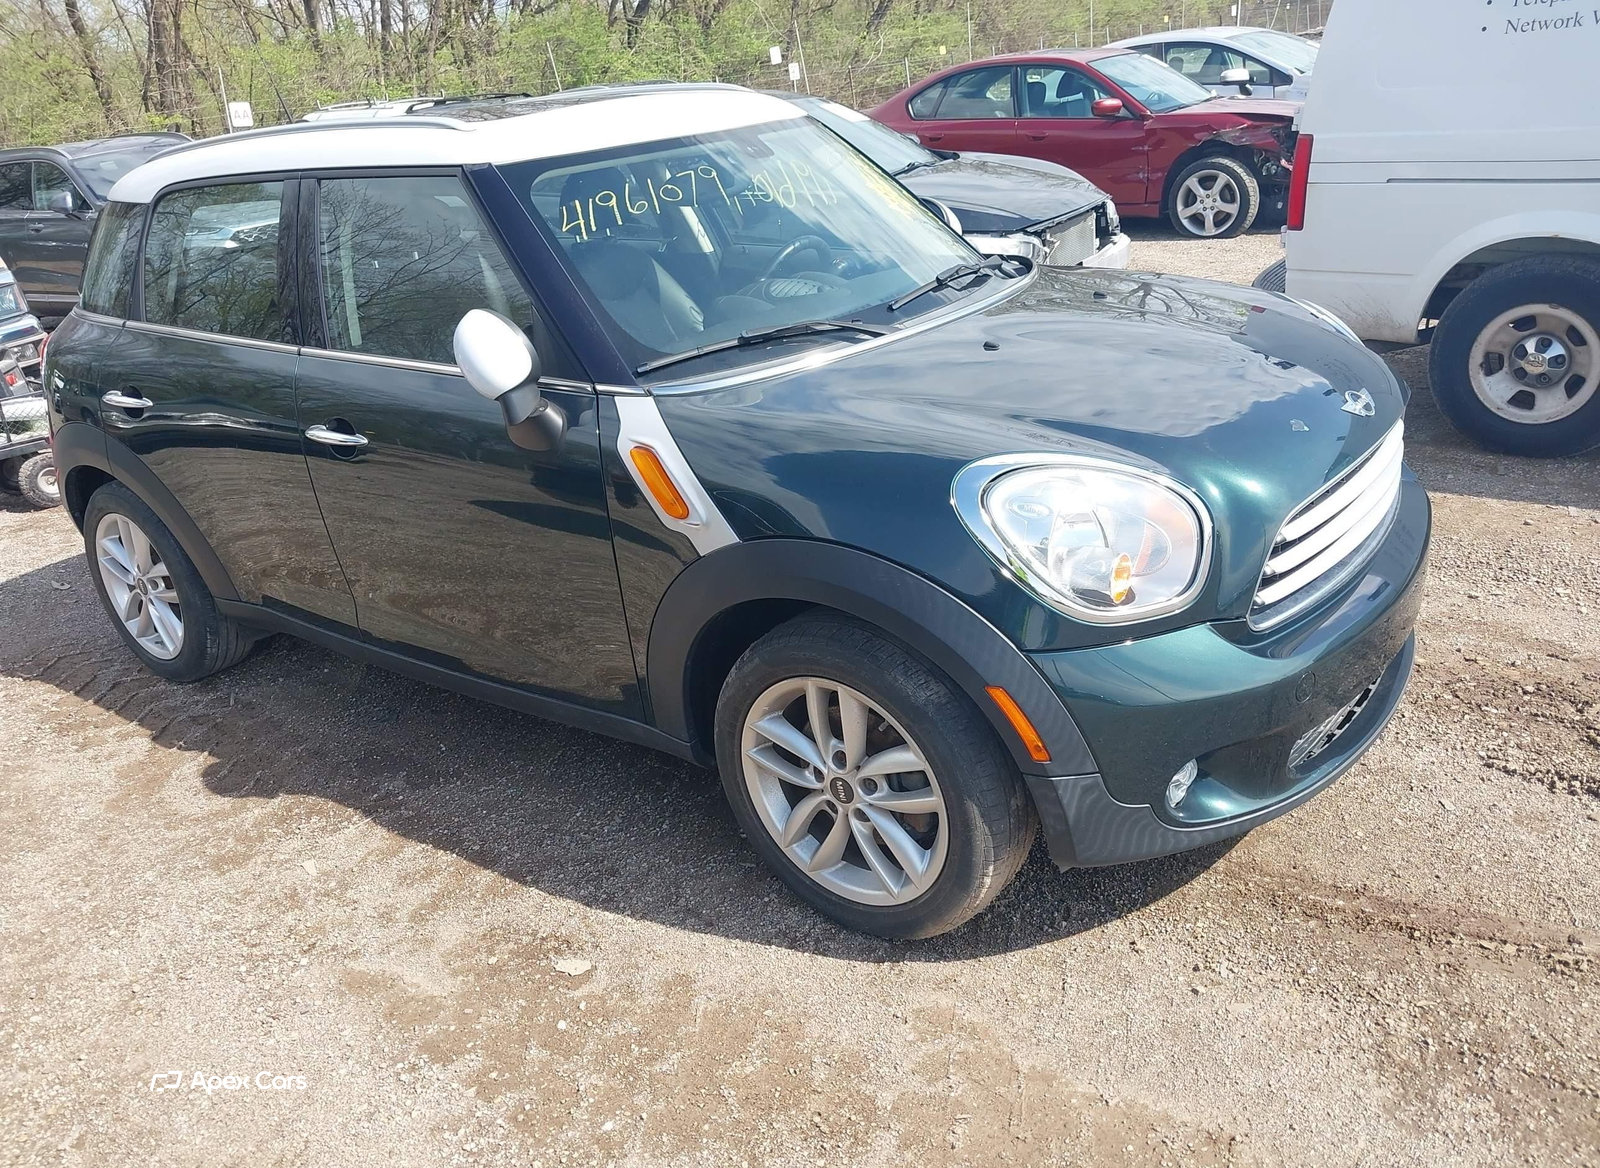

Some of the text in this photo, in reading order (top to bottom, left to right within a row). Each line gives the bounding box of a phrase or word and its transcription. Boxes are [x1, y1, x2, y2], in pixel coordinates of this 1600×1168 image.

[1504, 11, 1584, 34] Network
[562, 165, 731, 241] 41961079
[836, 780, 847, 801] MINI
